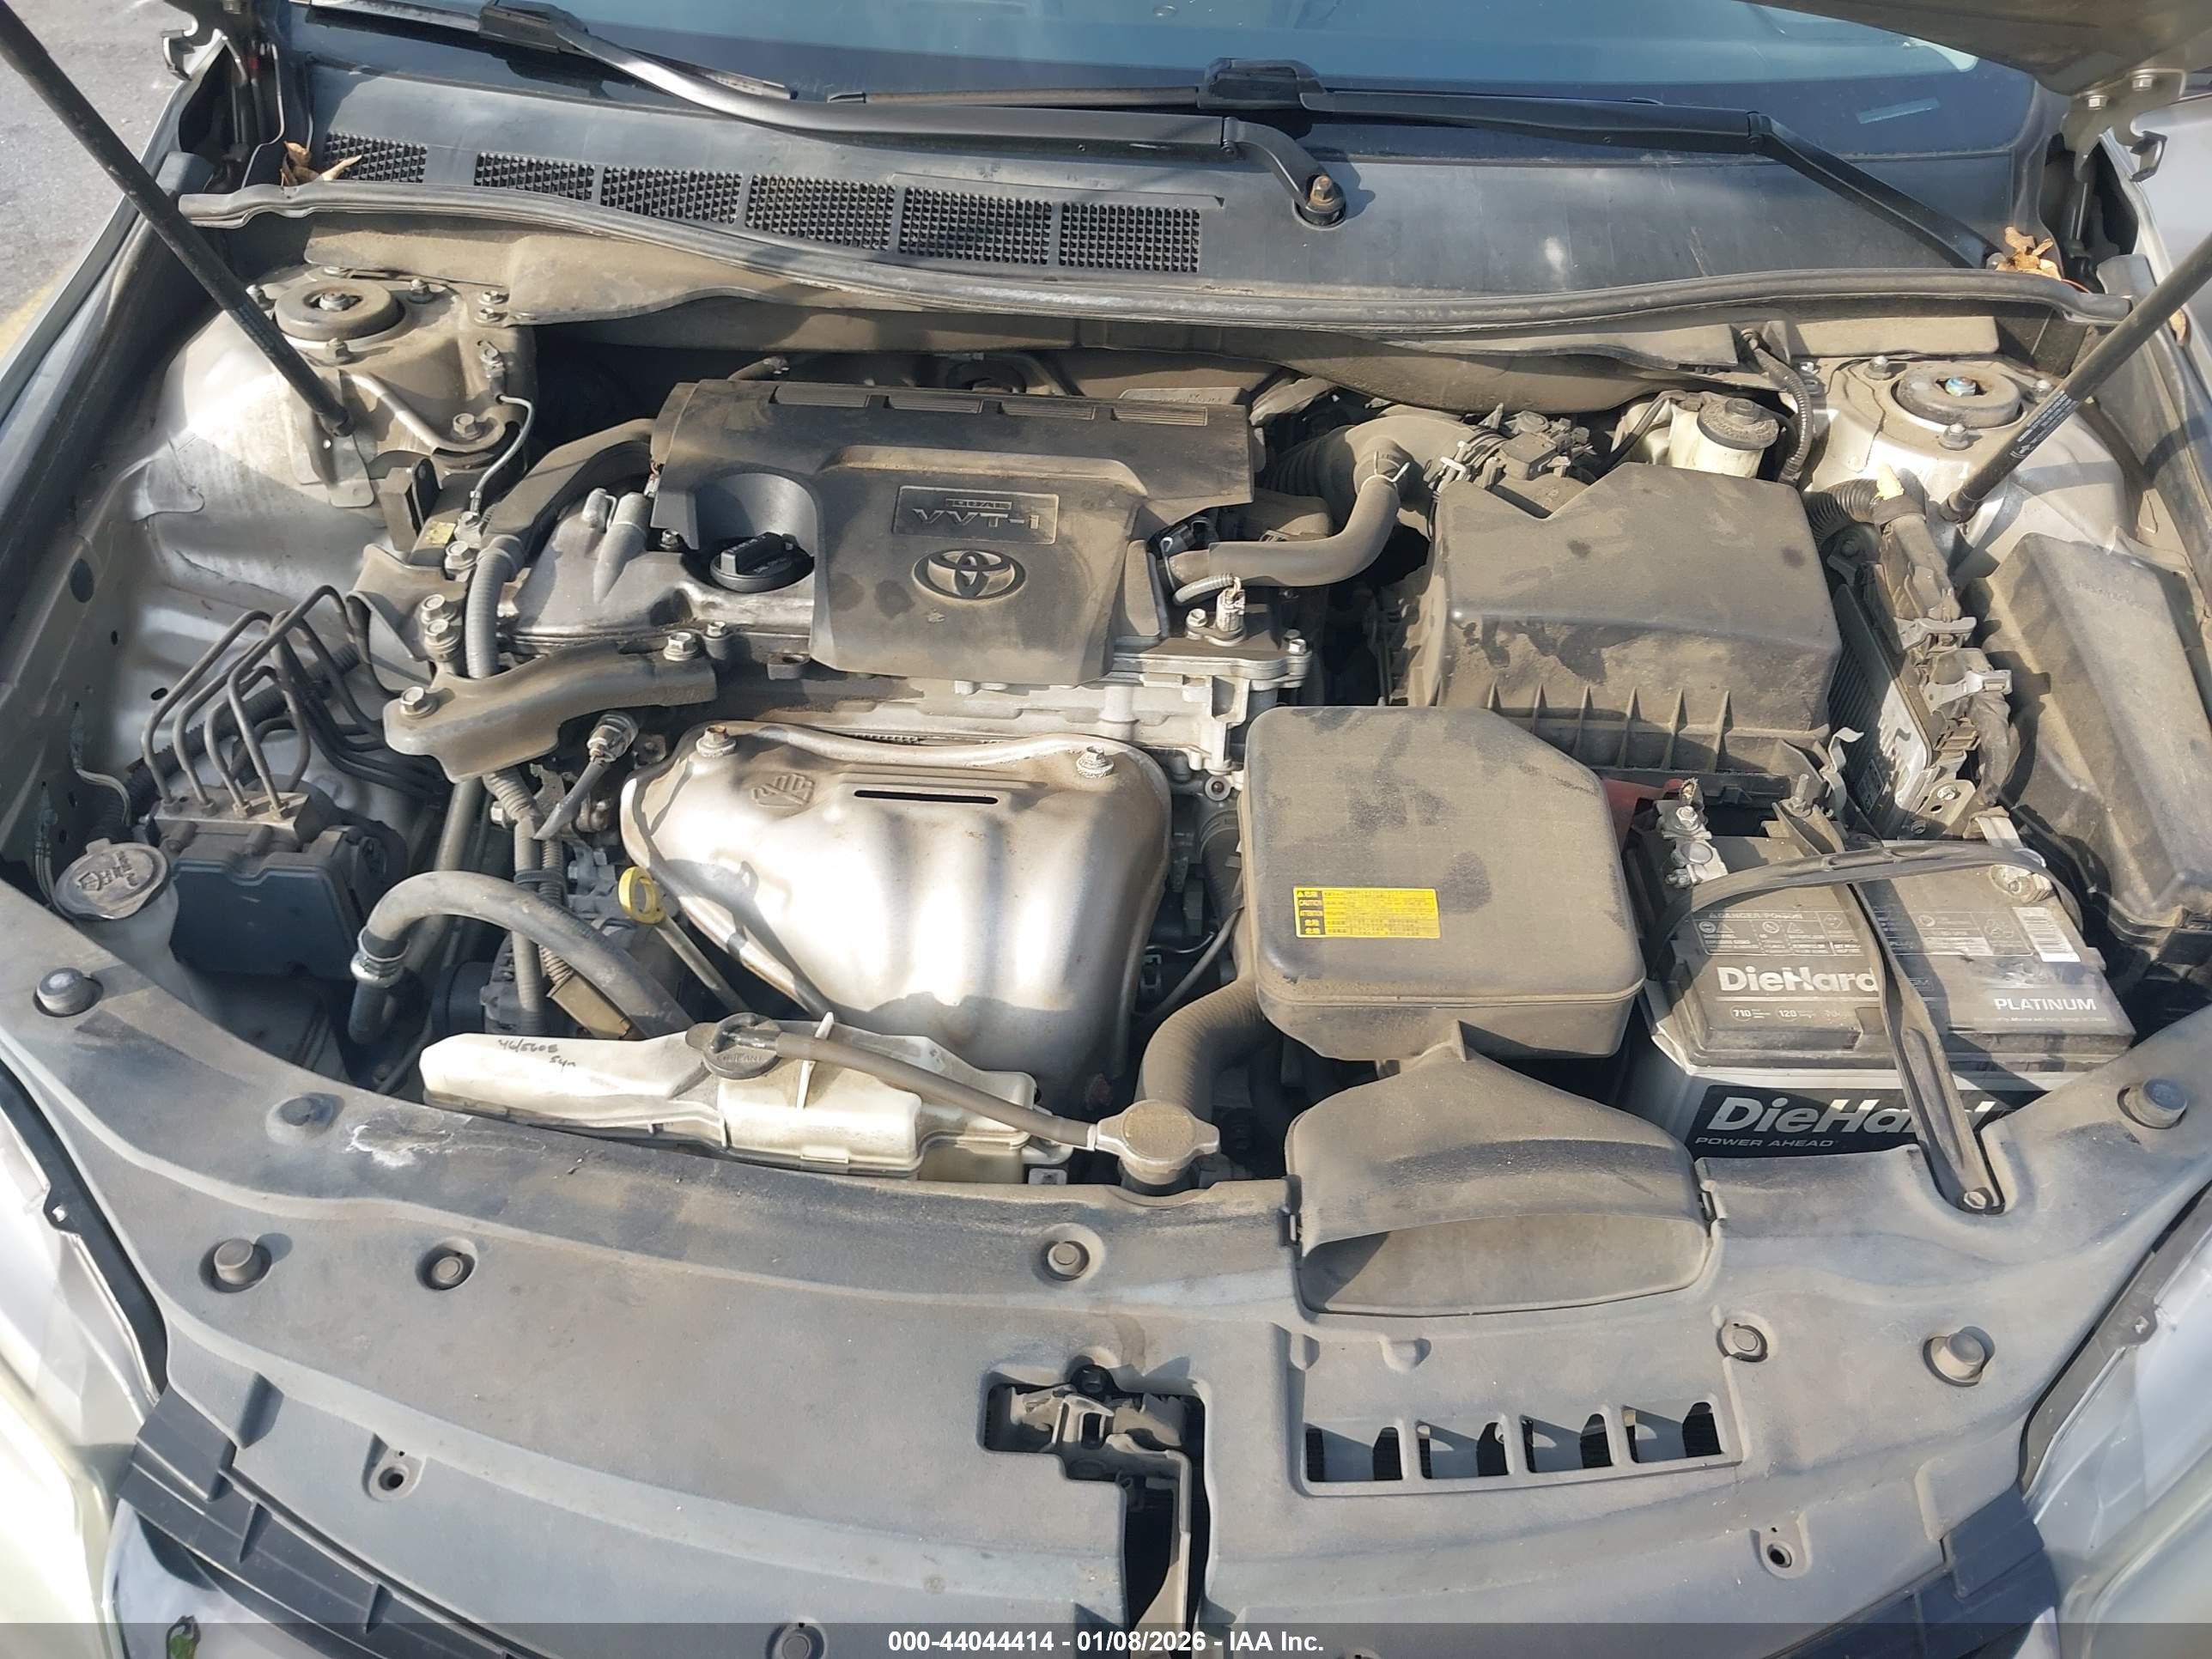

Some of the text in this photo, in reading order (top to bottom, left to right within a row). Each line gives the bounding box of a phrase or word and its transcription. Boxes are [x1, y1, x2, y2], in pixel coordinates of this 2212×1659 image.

[1992, 997, 2097, 1011] PLATINUM
[1732, 1009, 1752, 1018] 710
[1778, 1009, 1798, 1018] 120
[1694, 1136, 1835, 1147] POWER AHEAD
